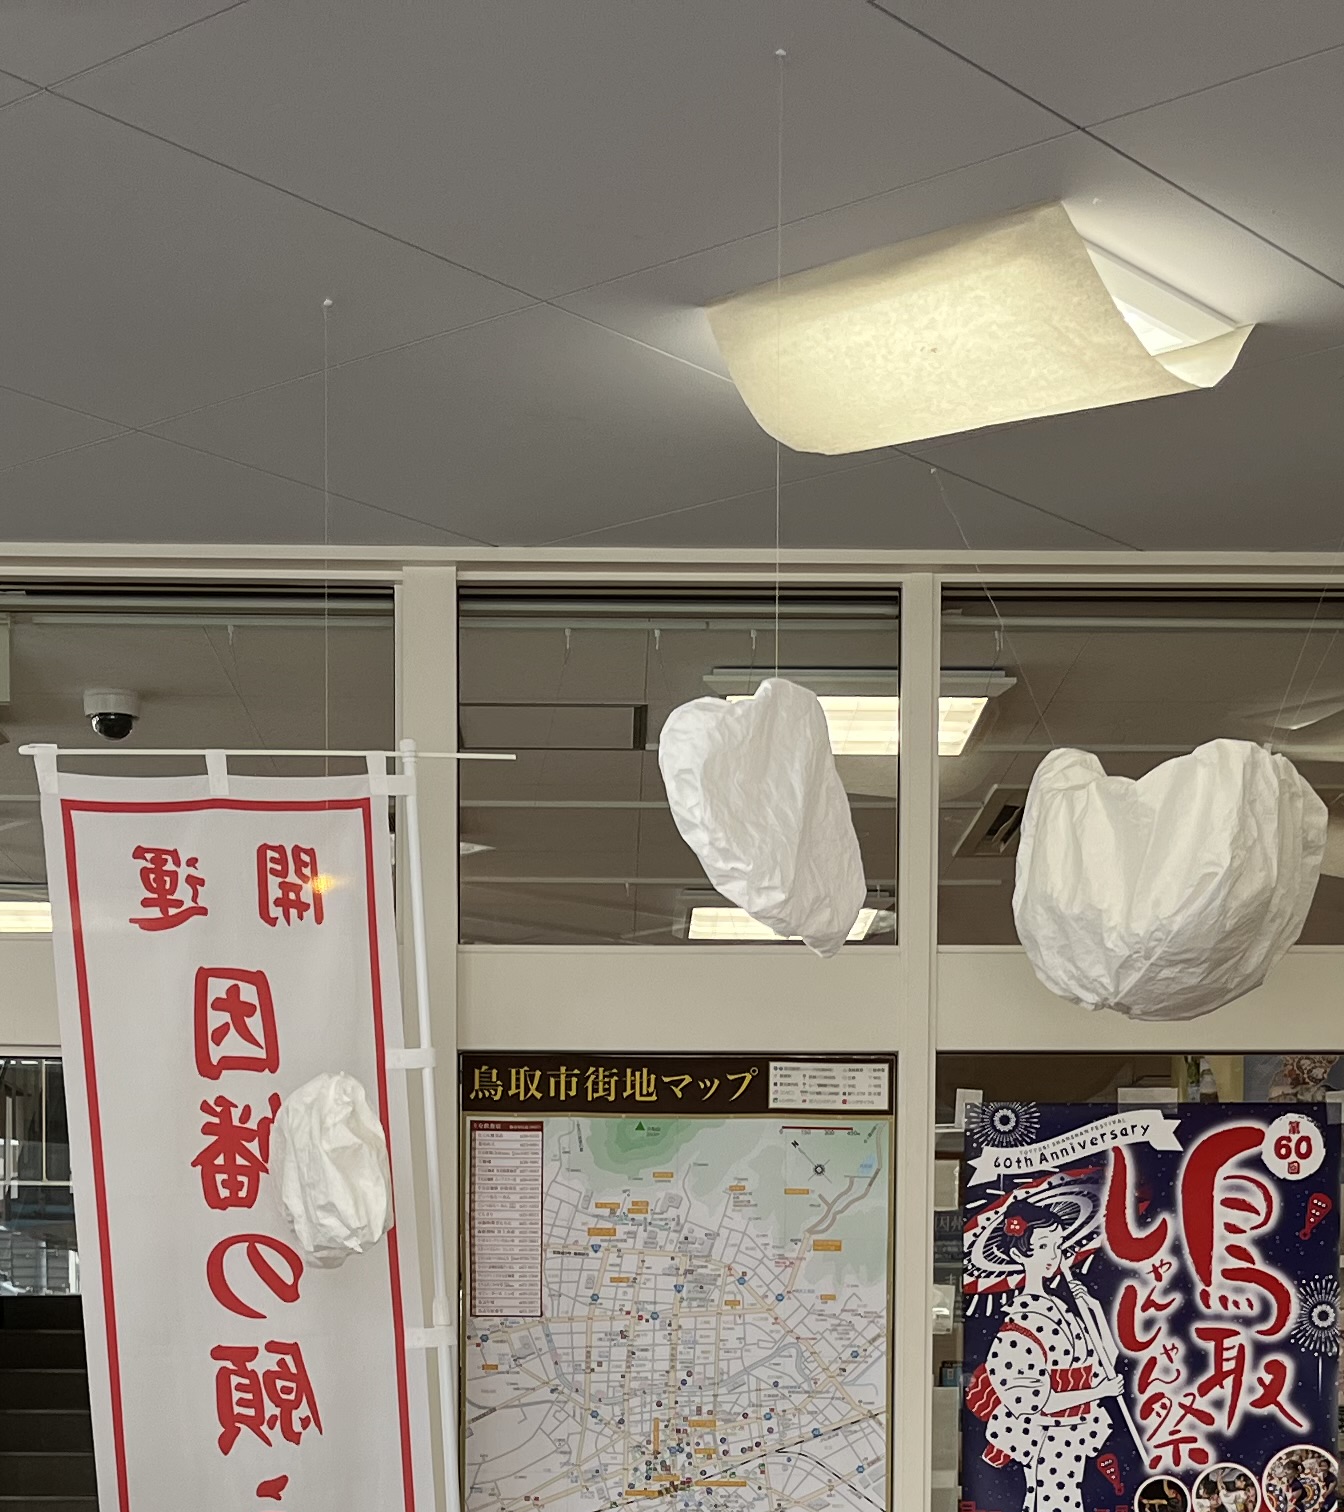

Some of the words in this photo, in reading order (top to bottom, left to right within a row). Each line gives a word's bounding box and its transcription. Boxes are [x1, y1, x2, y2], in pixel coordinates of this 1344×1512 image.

[469, 1064, 759, 1103] 鳥取市街地マップ
[993, 1155, 1034, 1170] 60th
[1039, 1123, 1151, 1165] Anniversary
[1104, 1145, 1215, 1470] しゃんしゃん祭
[1181, 1125, 1304, 1431] 鳥取
